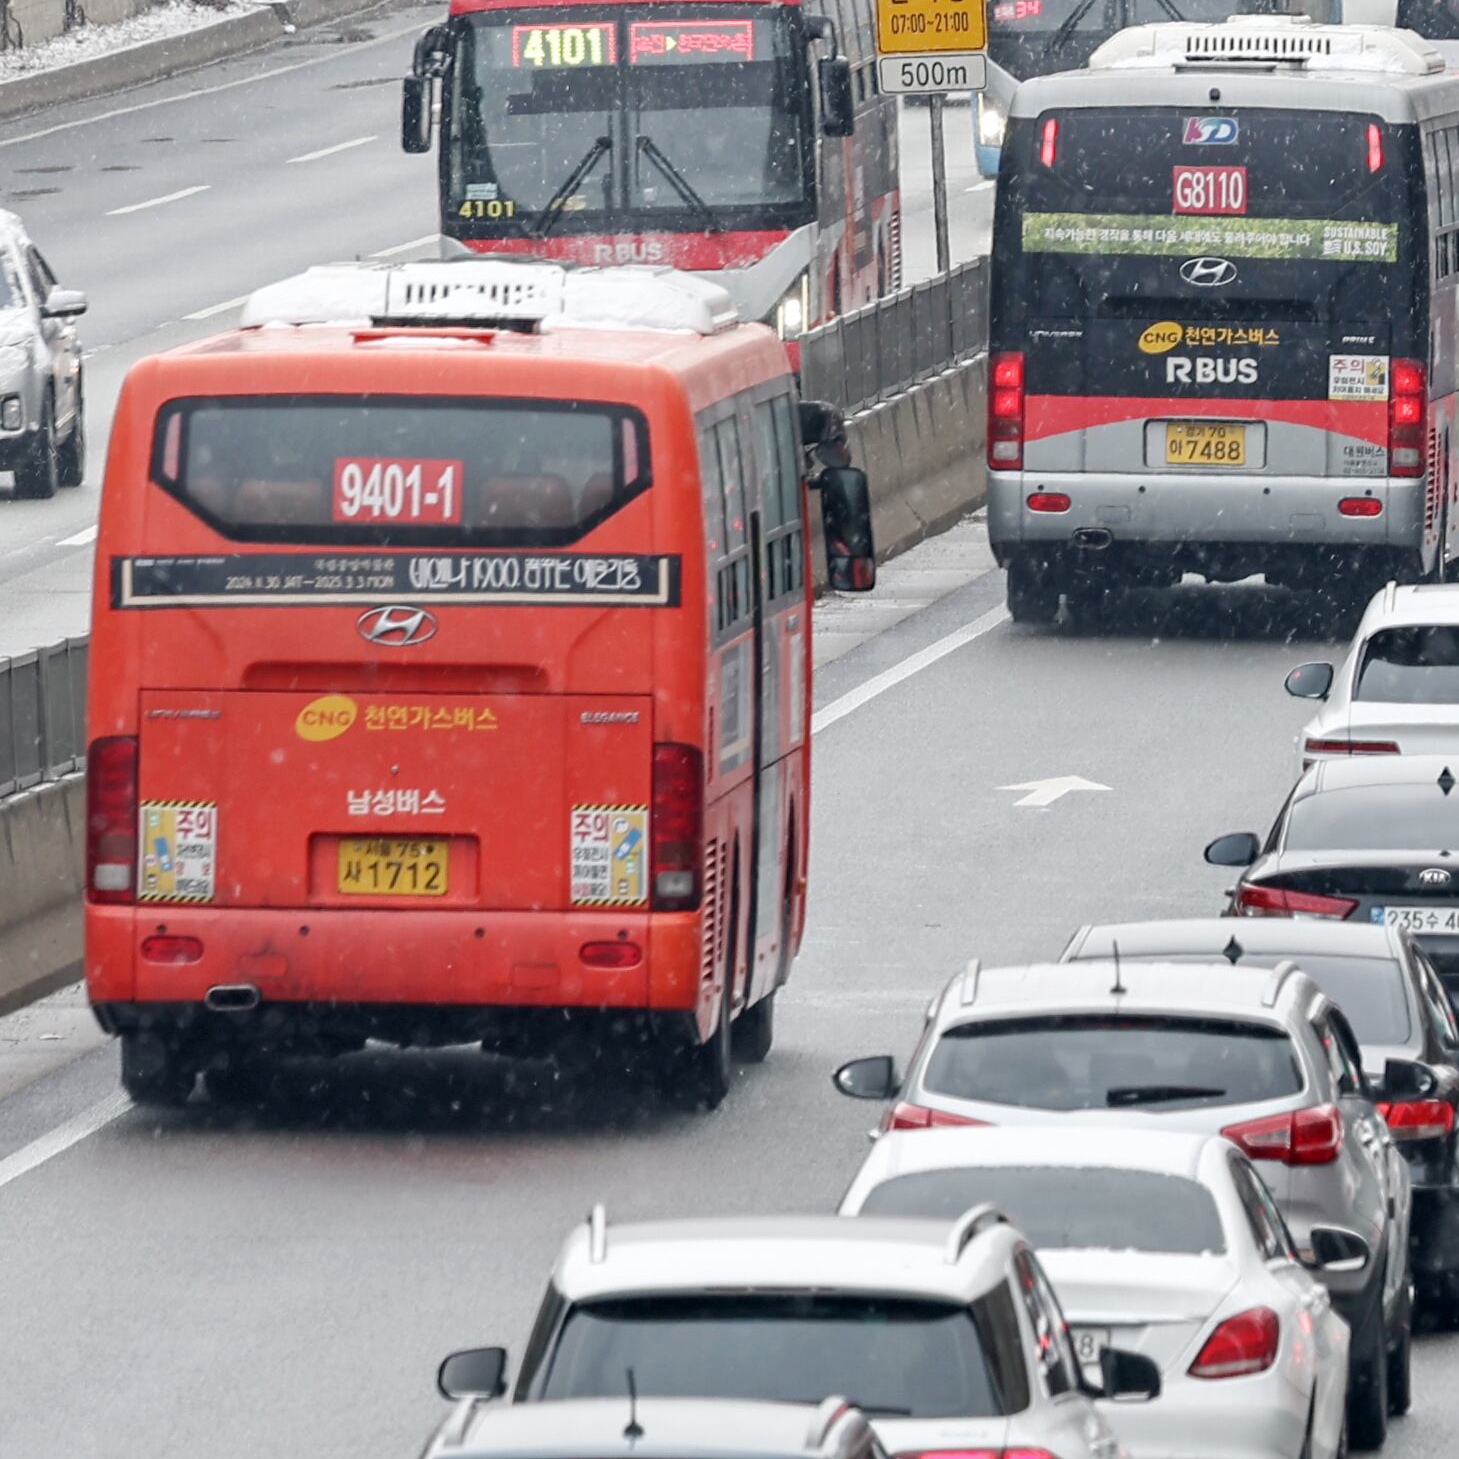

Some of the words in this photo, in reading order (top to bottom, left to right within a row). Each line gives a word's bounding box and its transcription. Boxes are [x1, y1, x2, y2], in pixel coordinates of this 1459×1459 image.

[891, 12, 970, 34] 07:00~21:00
[523, 28, 602, 67] 4101
[901, 61, 967, 87] 500m
[1177, 172, 1243, 209] G8110
[458, 200, 516, 218] 4101
[1323, 227, 1388, 240] SUSTAINABLE
[1365, 241, 1388, 256] SOY
[1144, 330, 1178, 344] CNG
[1185, 325, 1280, 346] 천연가스버스
[1333, 358, 1365, 374] 주의
[1208, 427, 1226, 438] 70
[1186, 441, 1241, 461] 7488
[1343, 445, 1385, 458] 대원버스
[341, 460, 455, 520] 9401-1
[301, 710, 351, 728] CNG
[364, 705, 499, 731] 천연가스버스
[346, 789, 447, 817] 남성버스
[177, 810, 212, 841] 주의
[574, 813, 609, 843] 주의
[398, 841, 421, 857] 75
[367, 861, 443, 891] 1712
[1424, 871, 1447, 883] KIA
